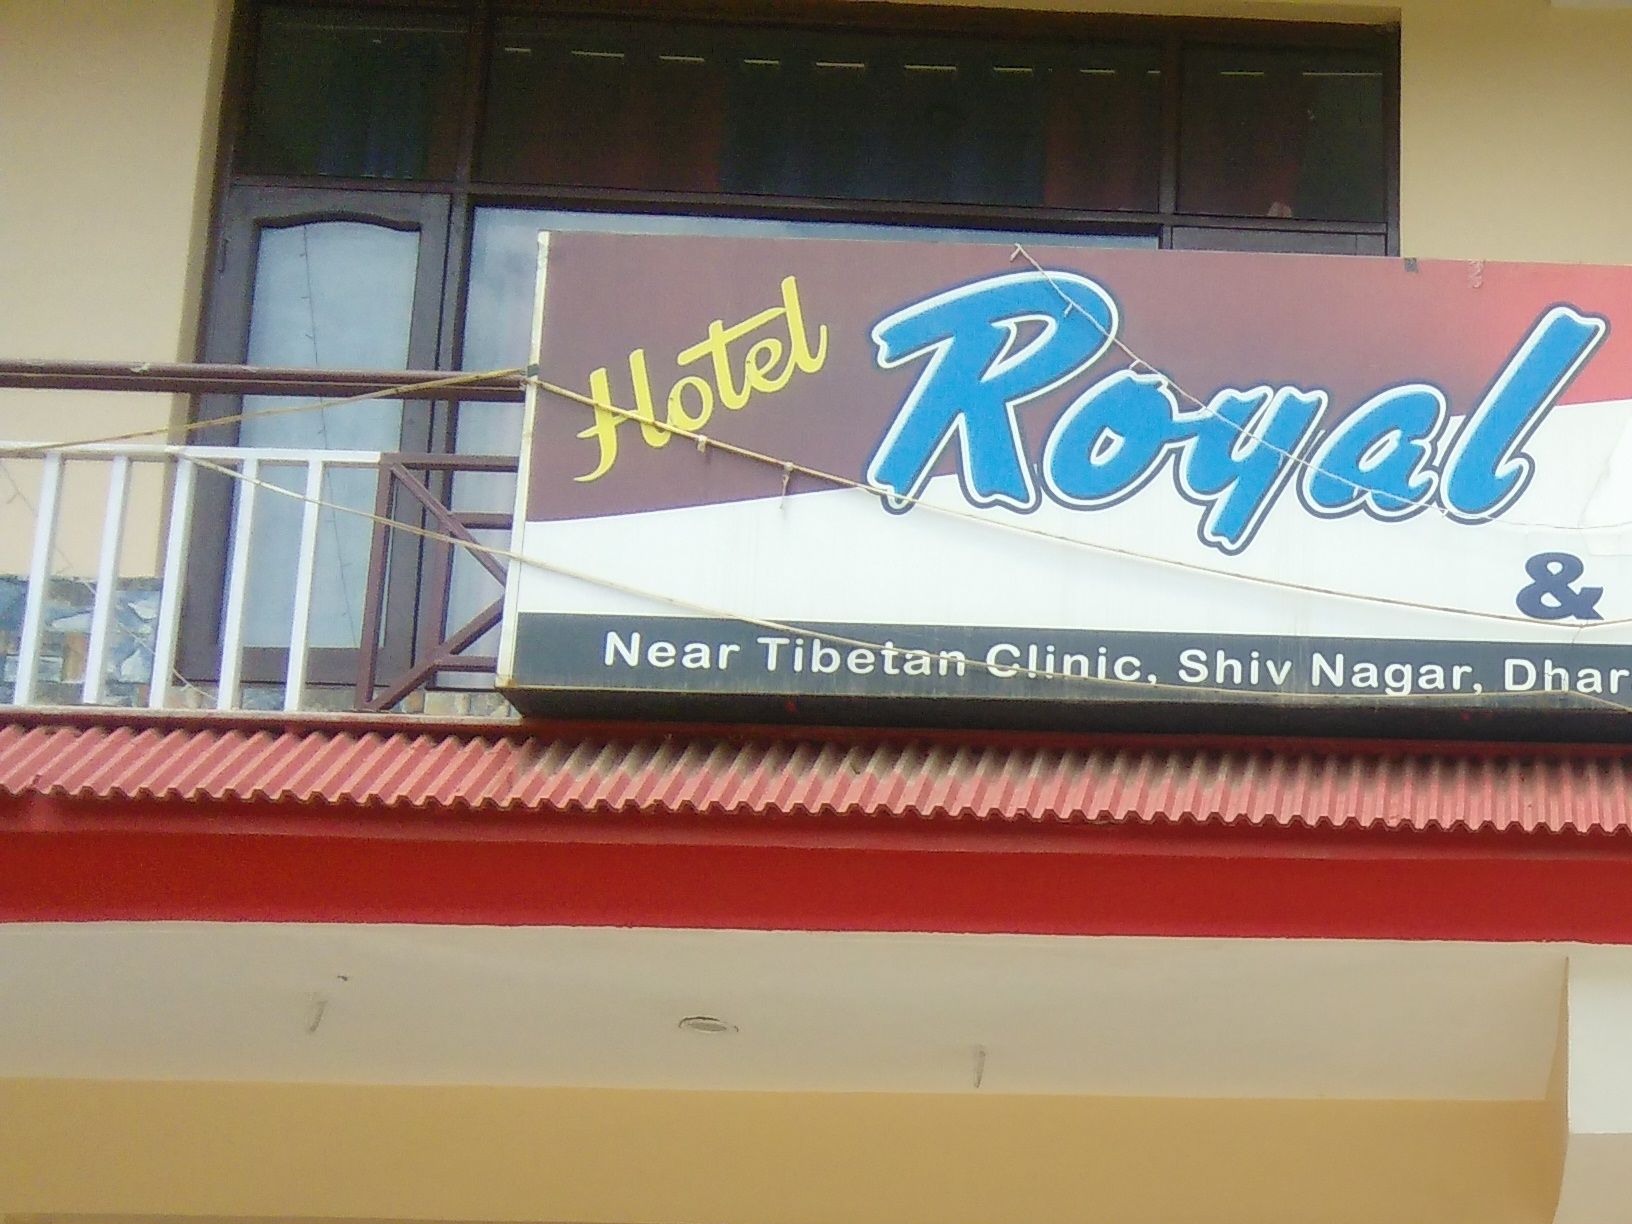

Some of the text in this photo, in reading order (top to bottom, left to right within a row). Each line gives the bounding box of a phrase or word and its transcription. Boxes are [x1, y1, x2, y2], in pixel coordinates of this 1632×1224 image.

[573, 275, 830, 483] Hotel
[862, 269, 1612, 556] Royal
[1514, 551, 1606, 622] &
[604, 630, 739, 672] Near
[758, 636, 967, 680] Tibetan
[985, 642, 1159, 687] Clinic,
[1178, 647, 1292, 689] Shiv
[1311, 653, 1485, 697] Nagar,
